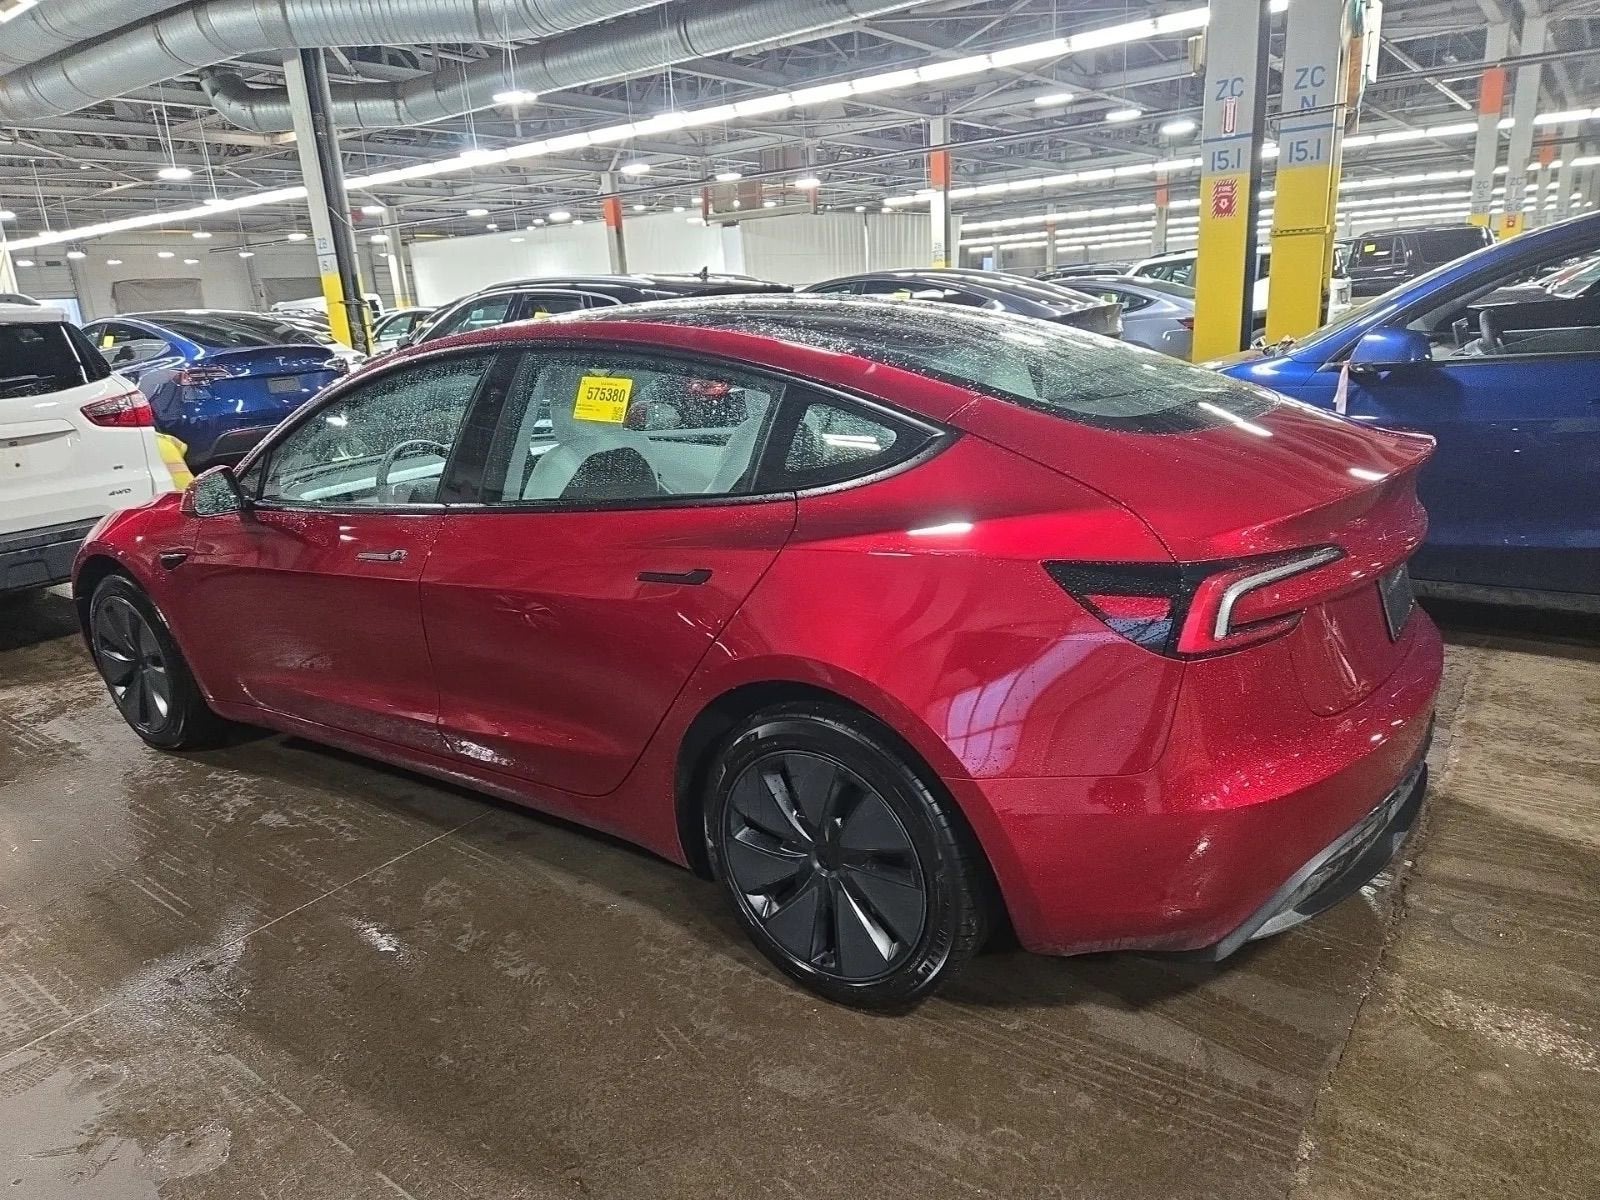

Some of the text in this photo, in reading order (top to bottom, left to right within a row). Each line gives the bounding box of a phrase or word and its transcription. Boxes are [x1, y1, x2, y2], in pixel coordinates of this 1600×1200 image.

[1216, 77, 1244, 101] ZC
[1295, 66, 1326, 90] ZC
[1211, 148, 1241, 172] 15.1
[1289, 138, 1321, 163] 15.1
[586, 387, 626, 402] 575380
[108, 488, 132, 496] 4WD
